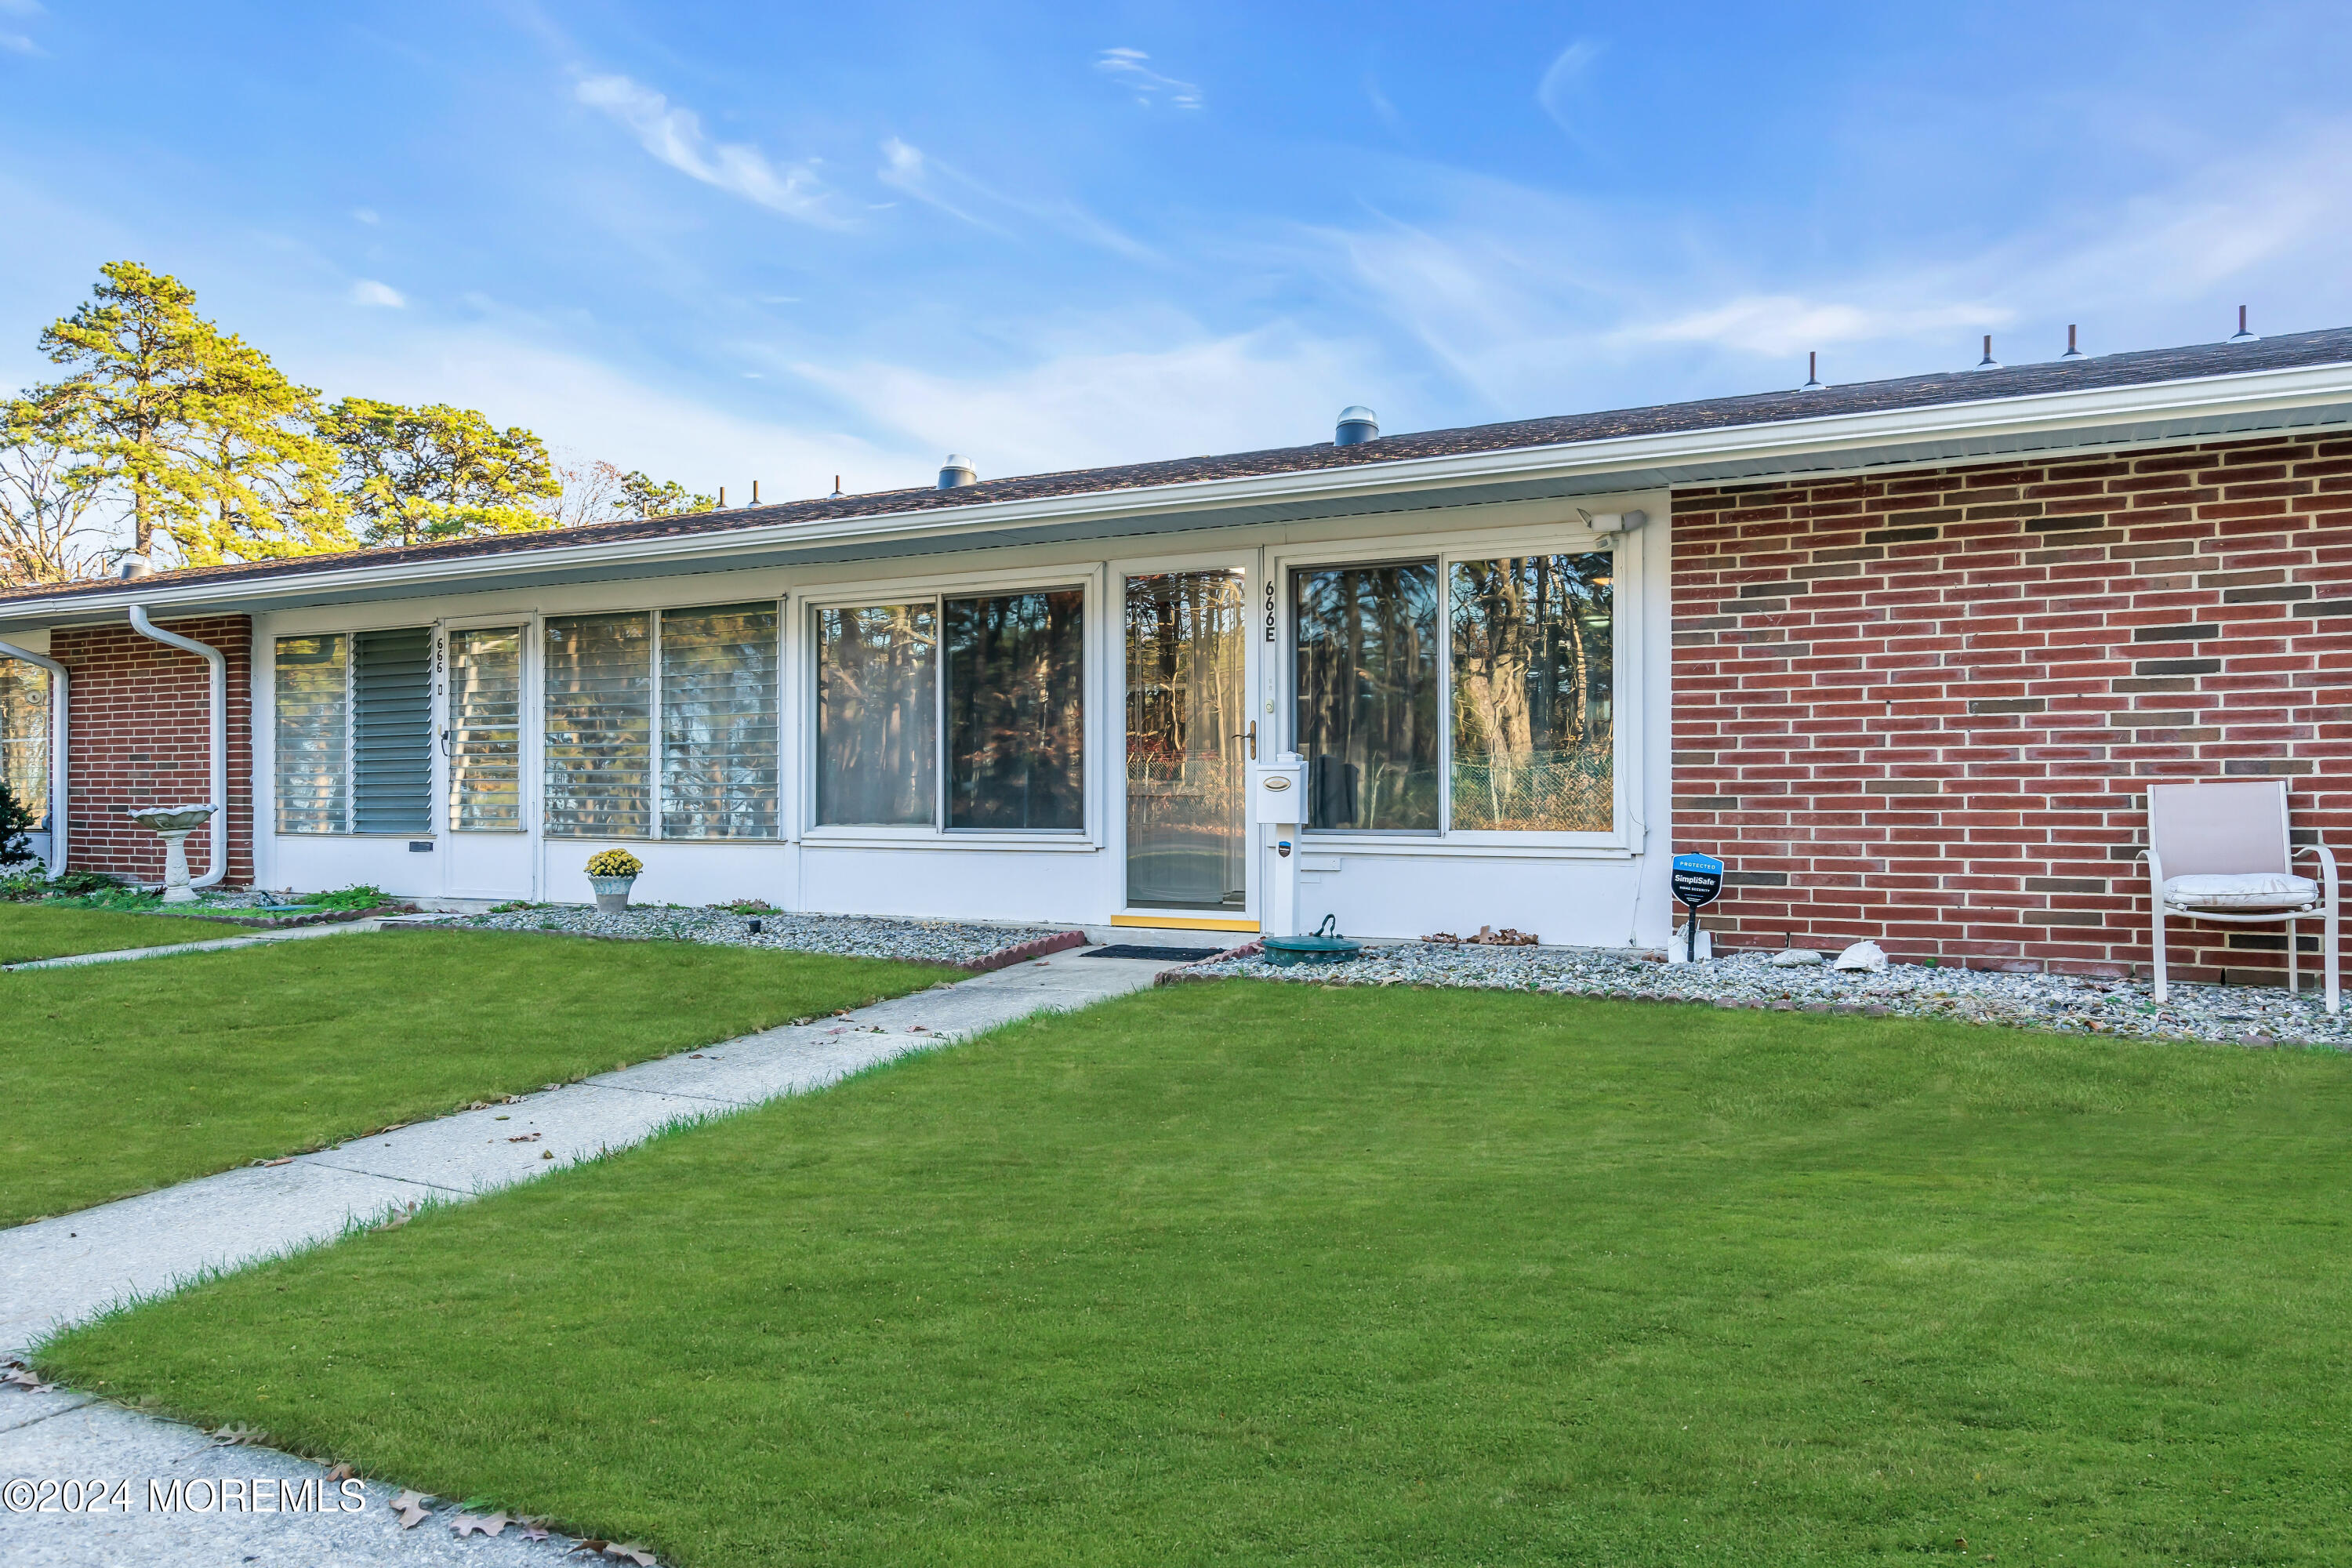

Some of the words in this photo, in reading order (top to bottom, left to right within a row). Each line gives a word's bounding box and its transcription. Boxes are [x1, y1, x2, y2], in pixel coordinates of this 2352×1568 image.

[1265, 581, 1275, 642] 666E
[1679, 861, 1715, 869] PROTECTED
[1675, 874, 1715, 885] SimpliSafe
